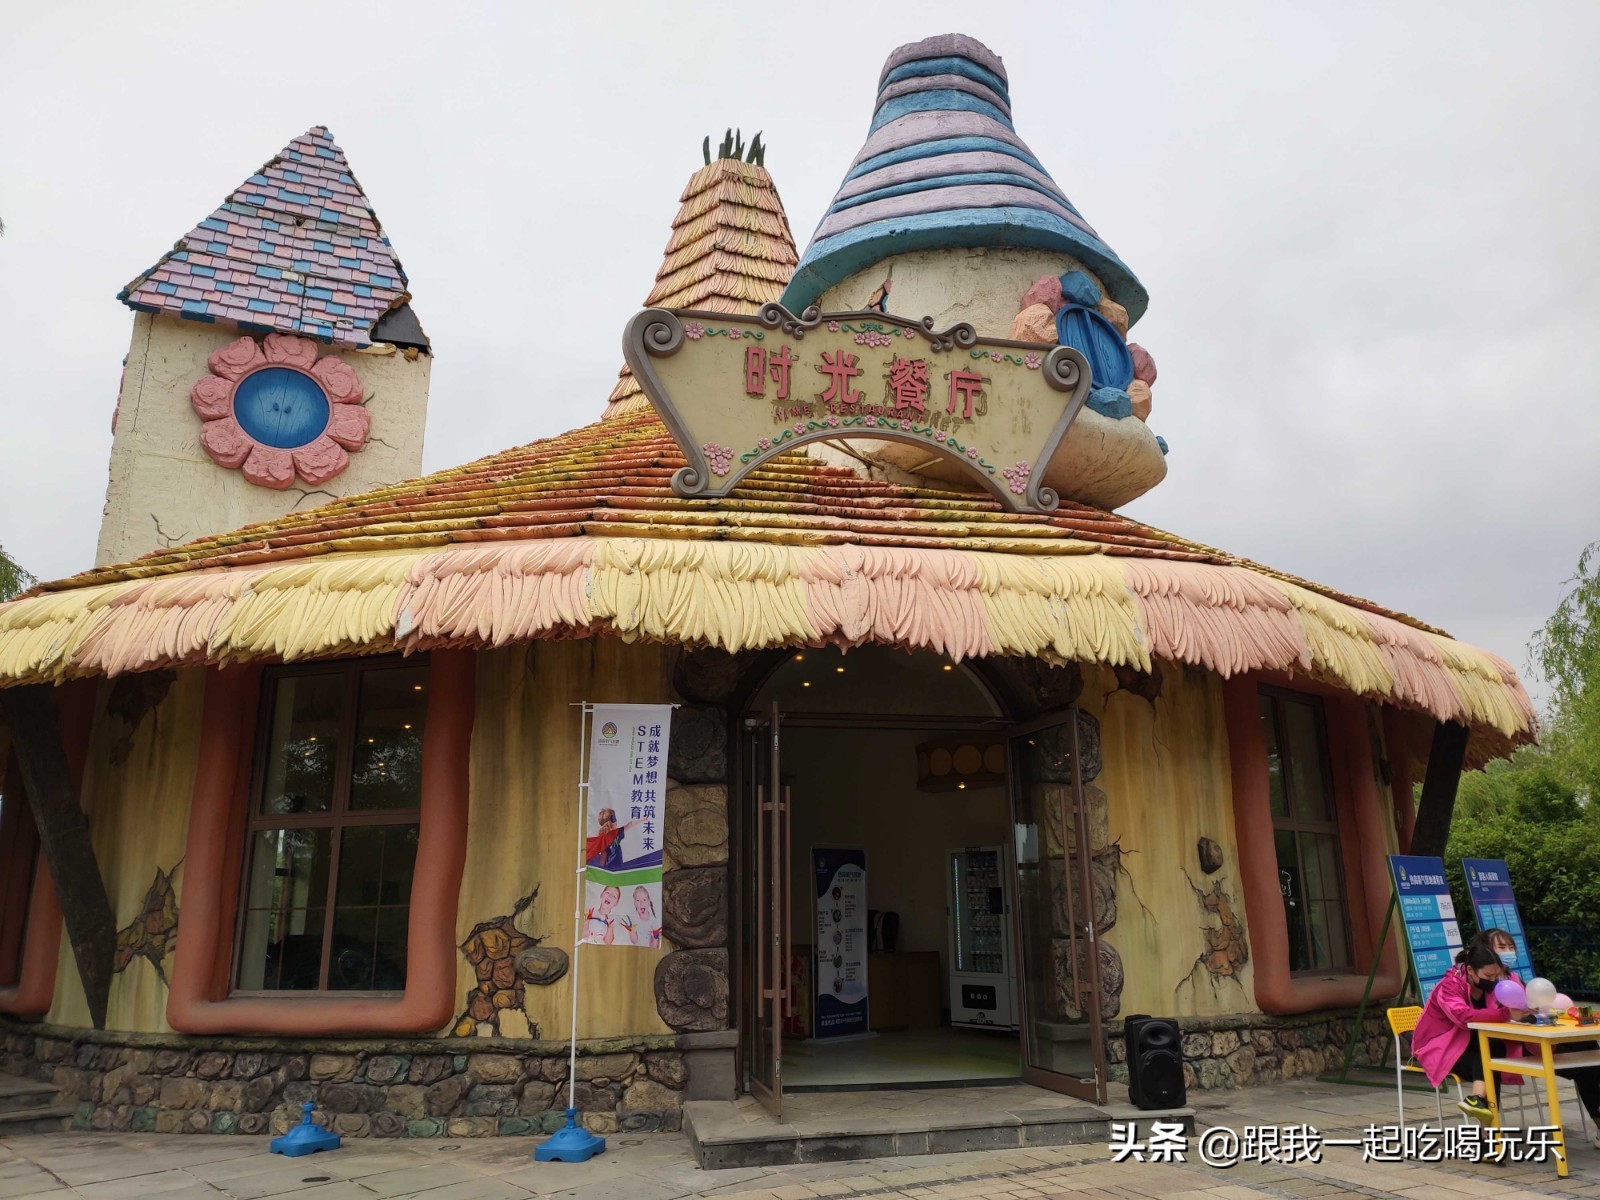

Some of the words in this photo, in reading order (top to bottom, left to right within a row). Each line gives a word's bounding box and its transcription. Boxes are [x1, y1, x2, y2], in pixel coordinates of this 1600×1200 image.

[745, 345, 984, 419] 时光餐厅
[830, 403, 924, 424] RESTAURANT
